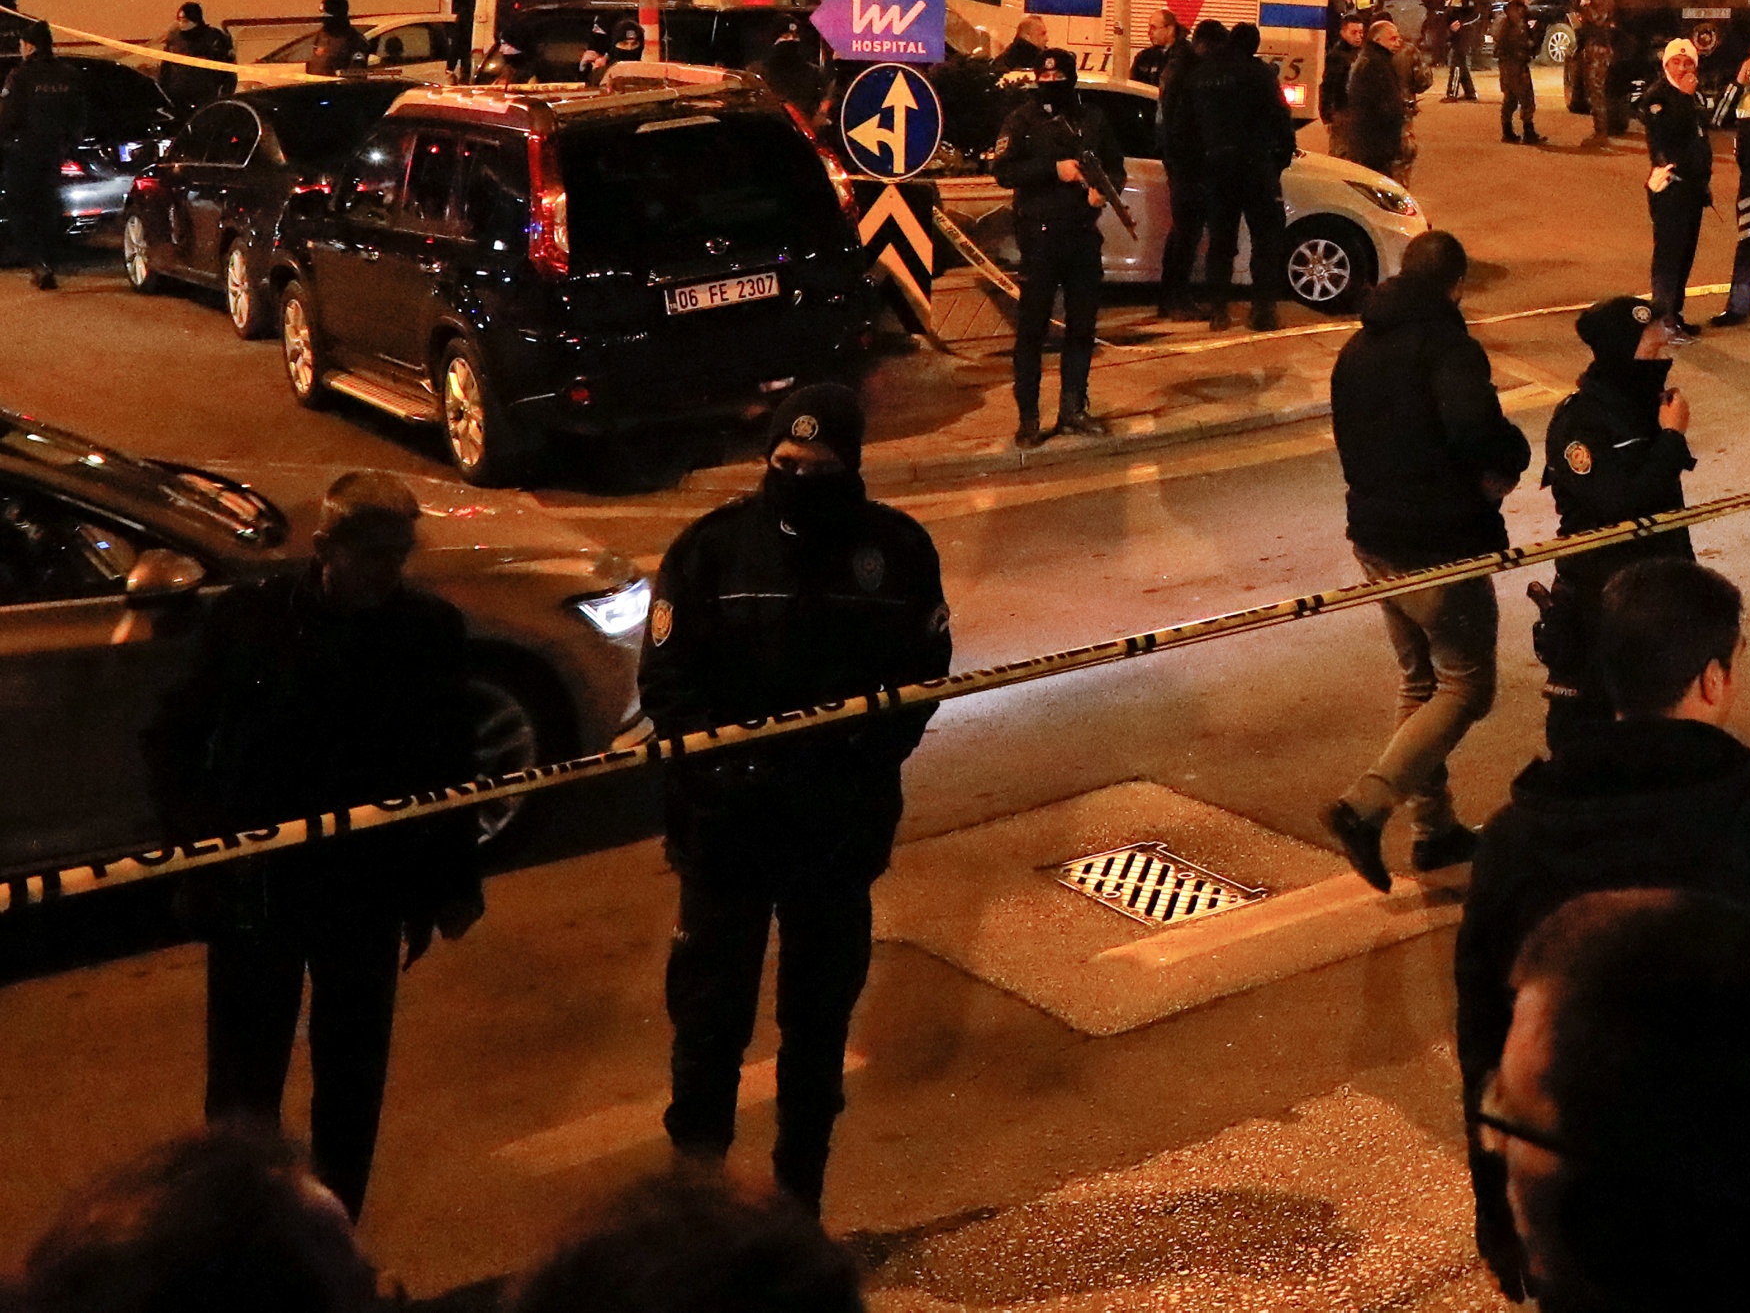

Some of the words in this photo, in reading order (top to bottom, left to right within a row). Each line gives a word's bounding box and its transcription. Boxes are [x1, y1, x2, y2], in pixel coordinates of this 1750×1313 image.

[852, 40, 926, 53] HOSPITAL
[678, 289, 699, 309] 06
[709, 283, 729, 304] FE
[736, 275, 773, 298] 2307
